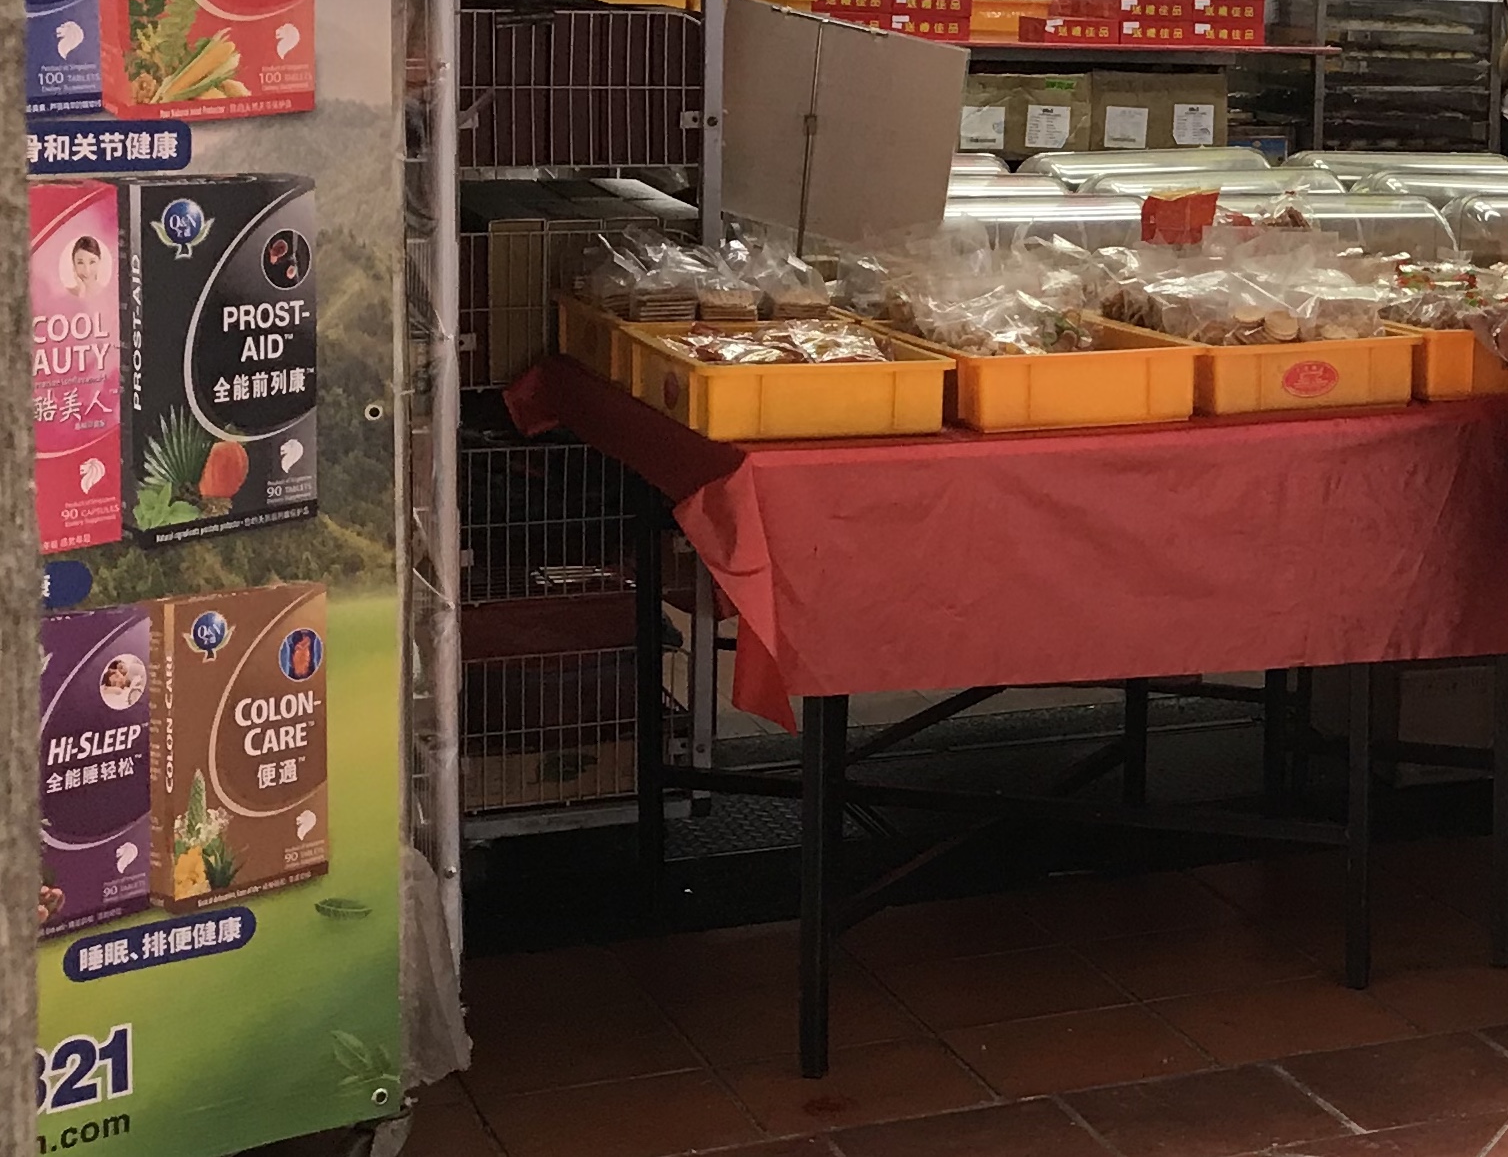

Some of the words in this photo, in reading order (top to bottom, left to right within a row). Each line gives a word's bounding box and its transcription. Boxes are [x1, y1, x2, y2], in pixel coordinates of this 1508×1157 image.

[38, 72, 63, 85] 100
[259, 72, 281, 84] 100
[169, 214, 197, 231] Q&N
[223, 300, 310, 332] PROST-
[32, 312, 110, 344] COOL
[267, 486, 282, 498] 90
[61, 508, 78, 520] 90
[235, 691, 321, 727] COLON-
[285, 852, 298, 863] 90
[102, 885, 118, 898] 90
[78, 916, 242, 972] 睡眠、排便健康
[34, 1025, 131, 1111] 21
